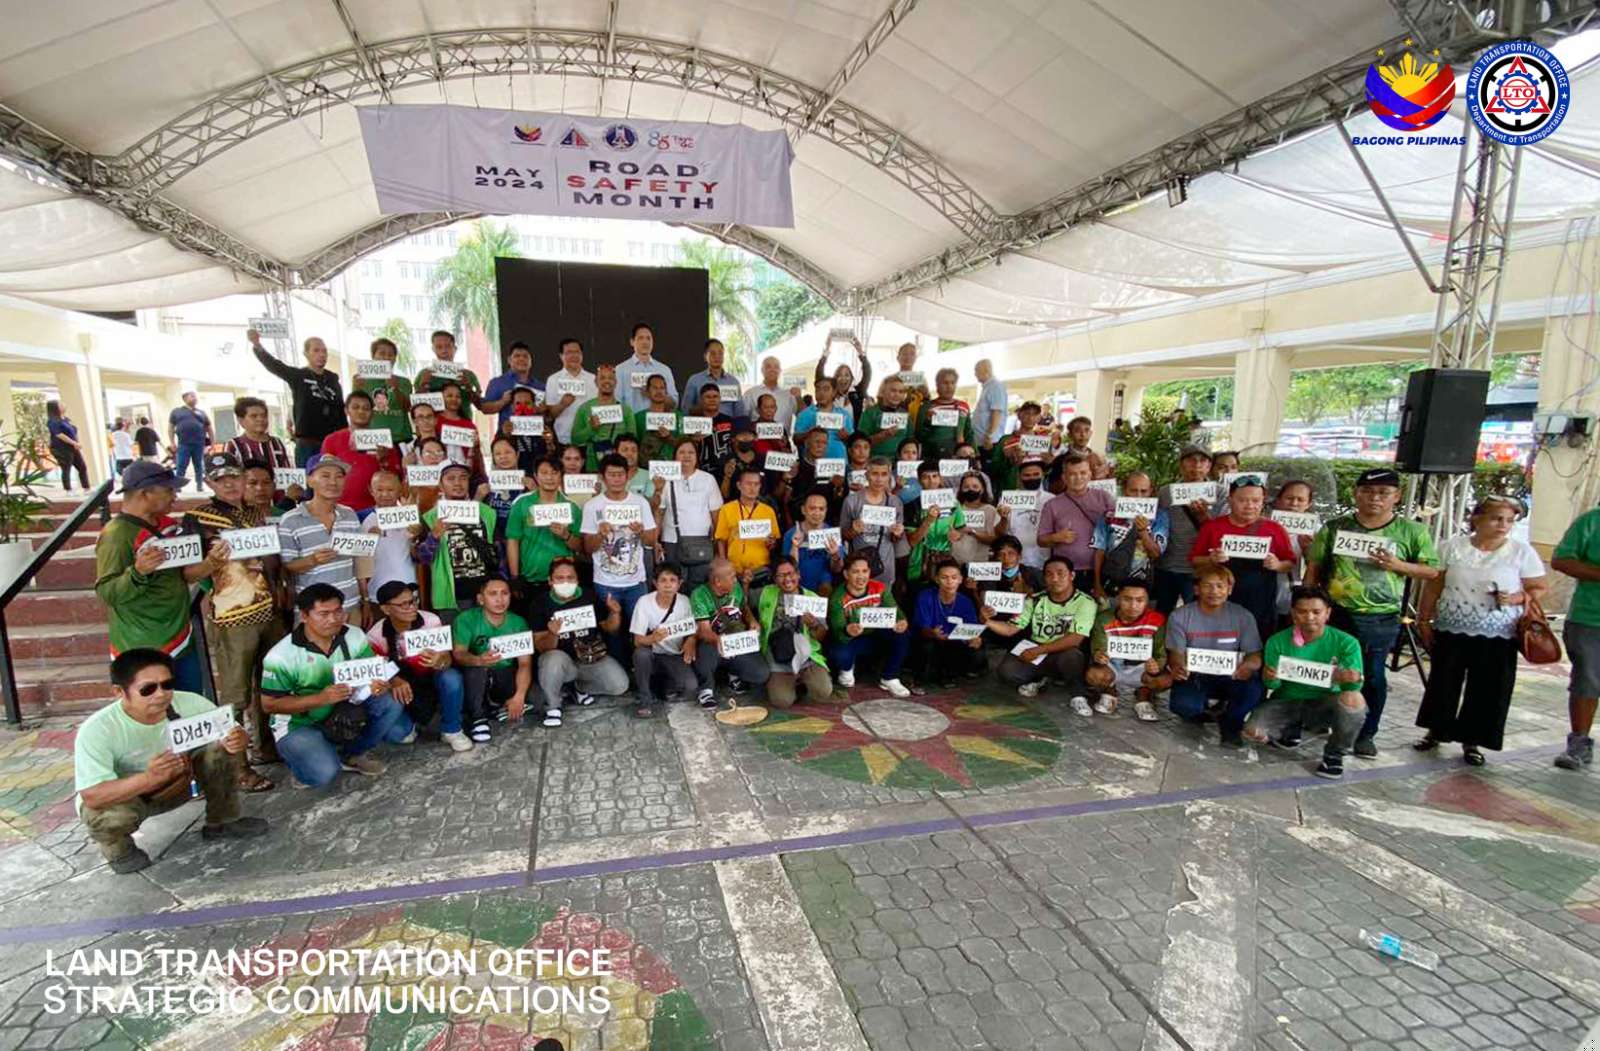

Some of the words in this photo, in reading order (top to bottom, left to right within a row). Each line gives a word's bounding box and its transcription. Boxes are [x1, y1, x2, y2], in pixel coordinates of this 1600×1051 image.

[476, 165, 541, 178] MAY
[588, 160, 700, 178] ROAD
[475, 177, 544, 190] 2024
[566, 175, 719, 194] SAFETY
[573, 191, 714, 210] MONTH
[666, 622, 697, 636] 1342M
